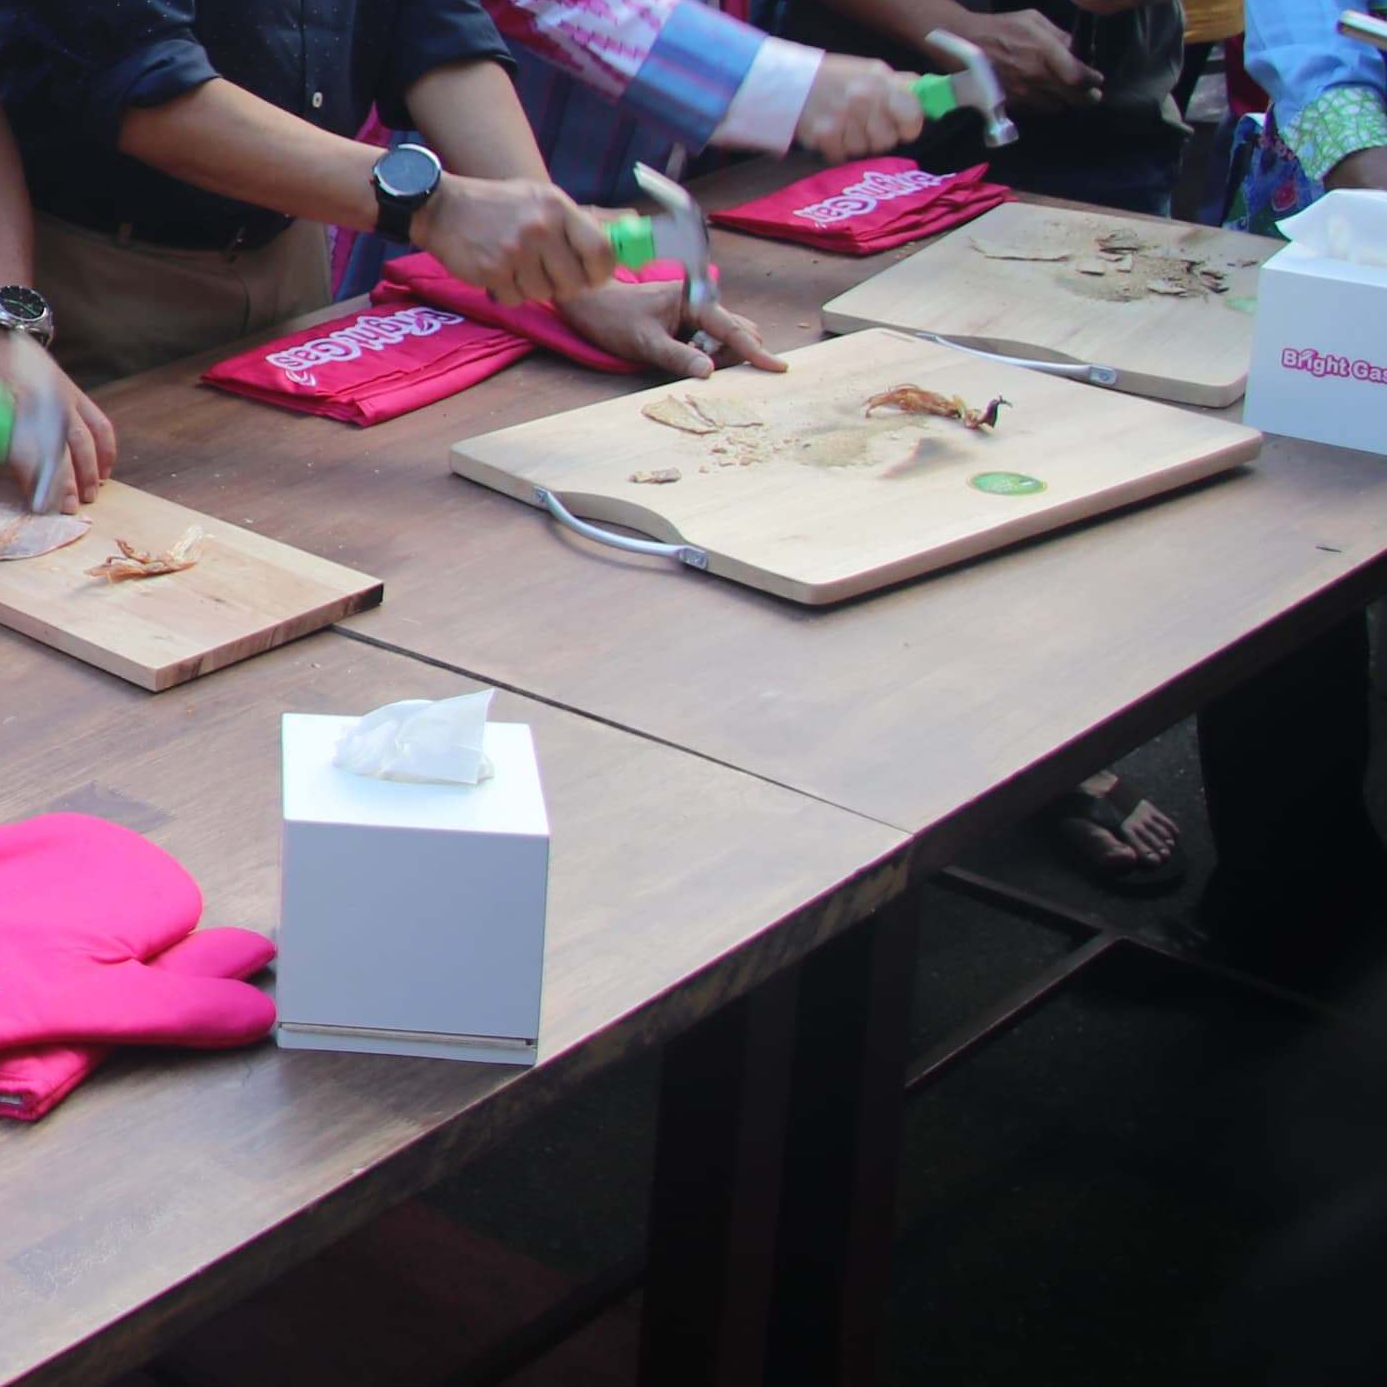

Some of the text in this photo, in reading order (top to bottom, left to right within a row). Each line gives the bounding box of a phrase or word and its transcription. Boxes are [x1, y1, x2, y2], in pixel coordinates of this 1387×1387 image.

[265, 338, 363, 372] Gas
[1282, 348, 1387, 385] Bright Gas
